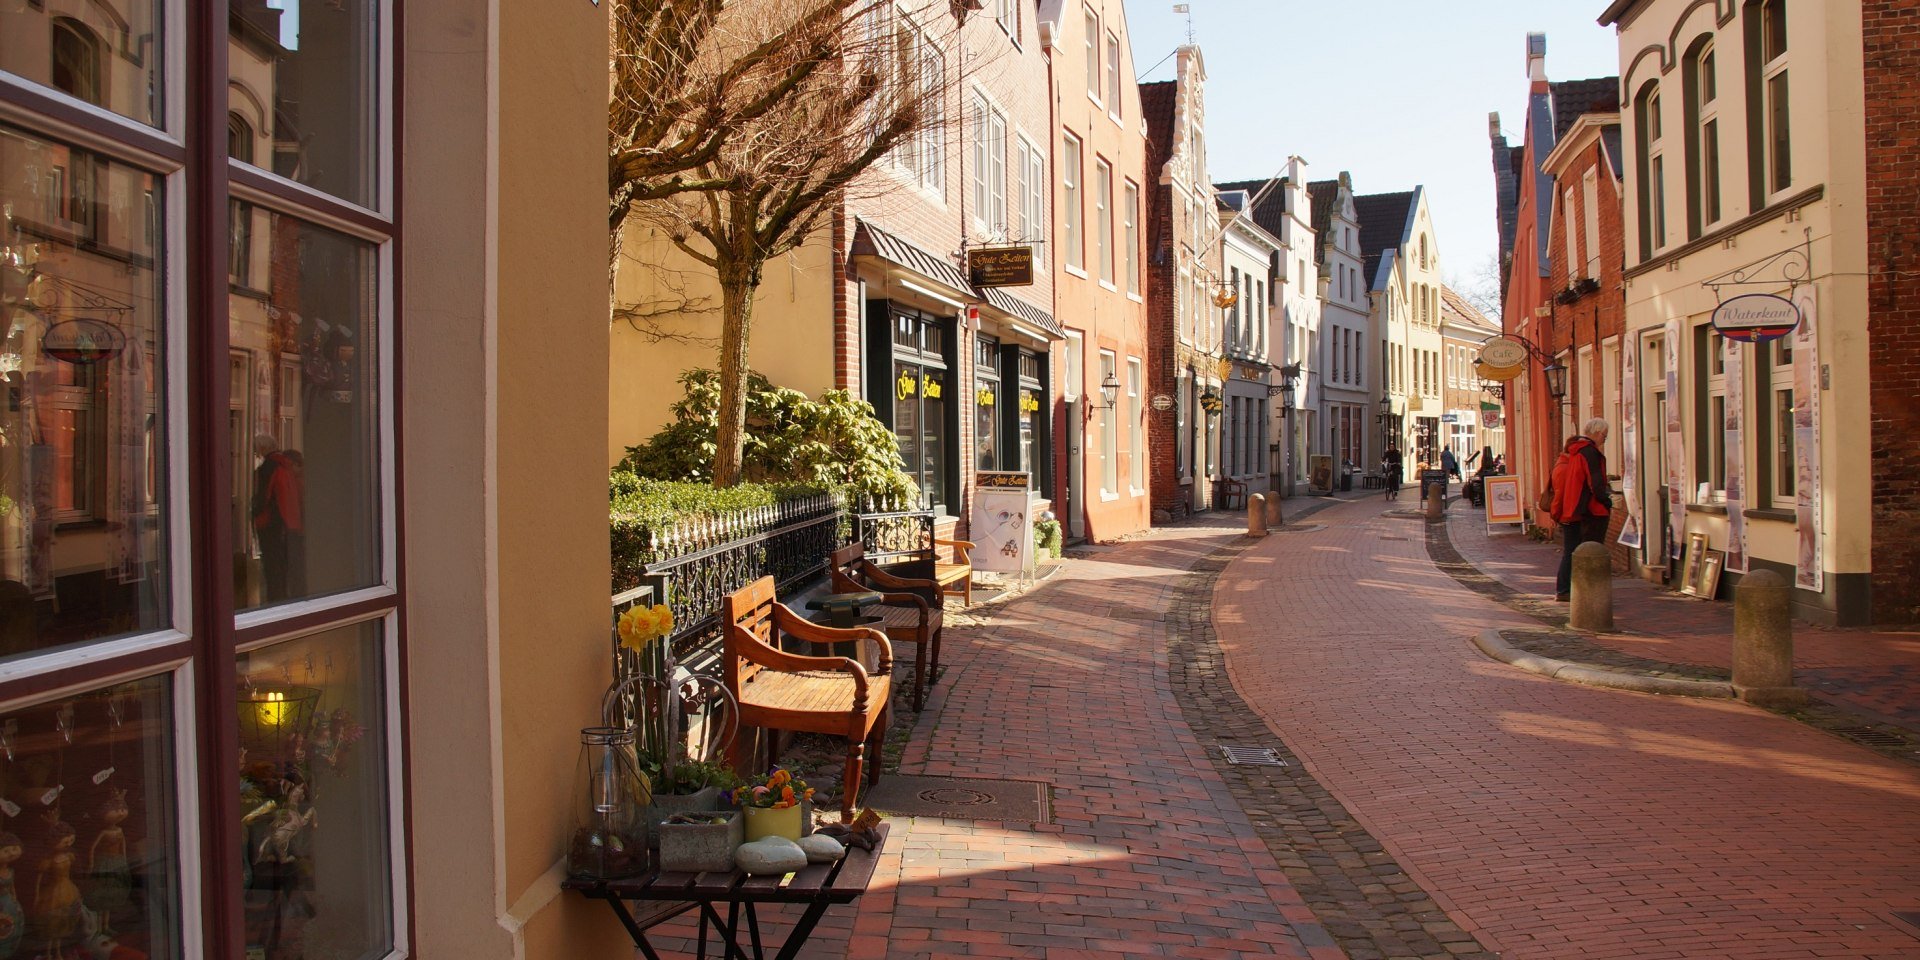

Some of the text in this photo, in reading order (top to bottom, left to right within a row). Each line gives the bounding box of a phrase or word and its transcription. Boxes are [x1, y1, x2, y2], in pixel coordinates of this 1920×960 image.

[972, 253, 1030, 268] Gute Zeiten
[1721, 306, 1792, 321] Waterkant
[898, 370, 941, 400] Gute Zeiten
